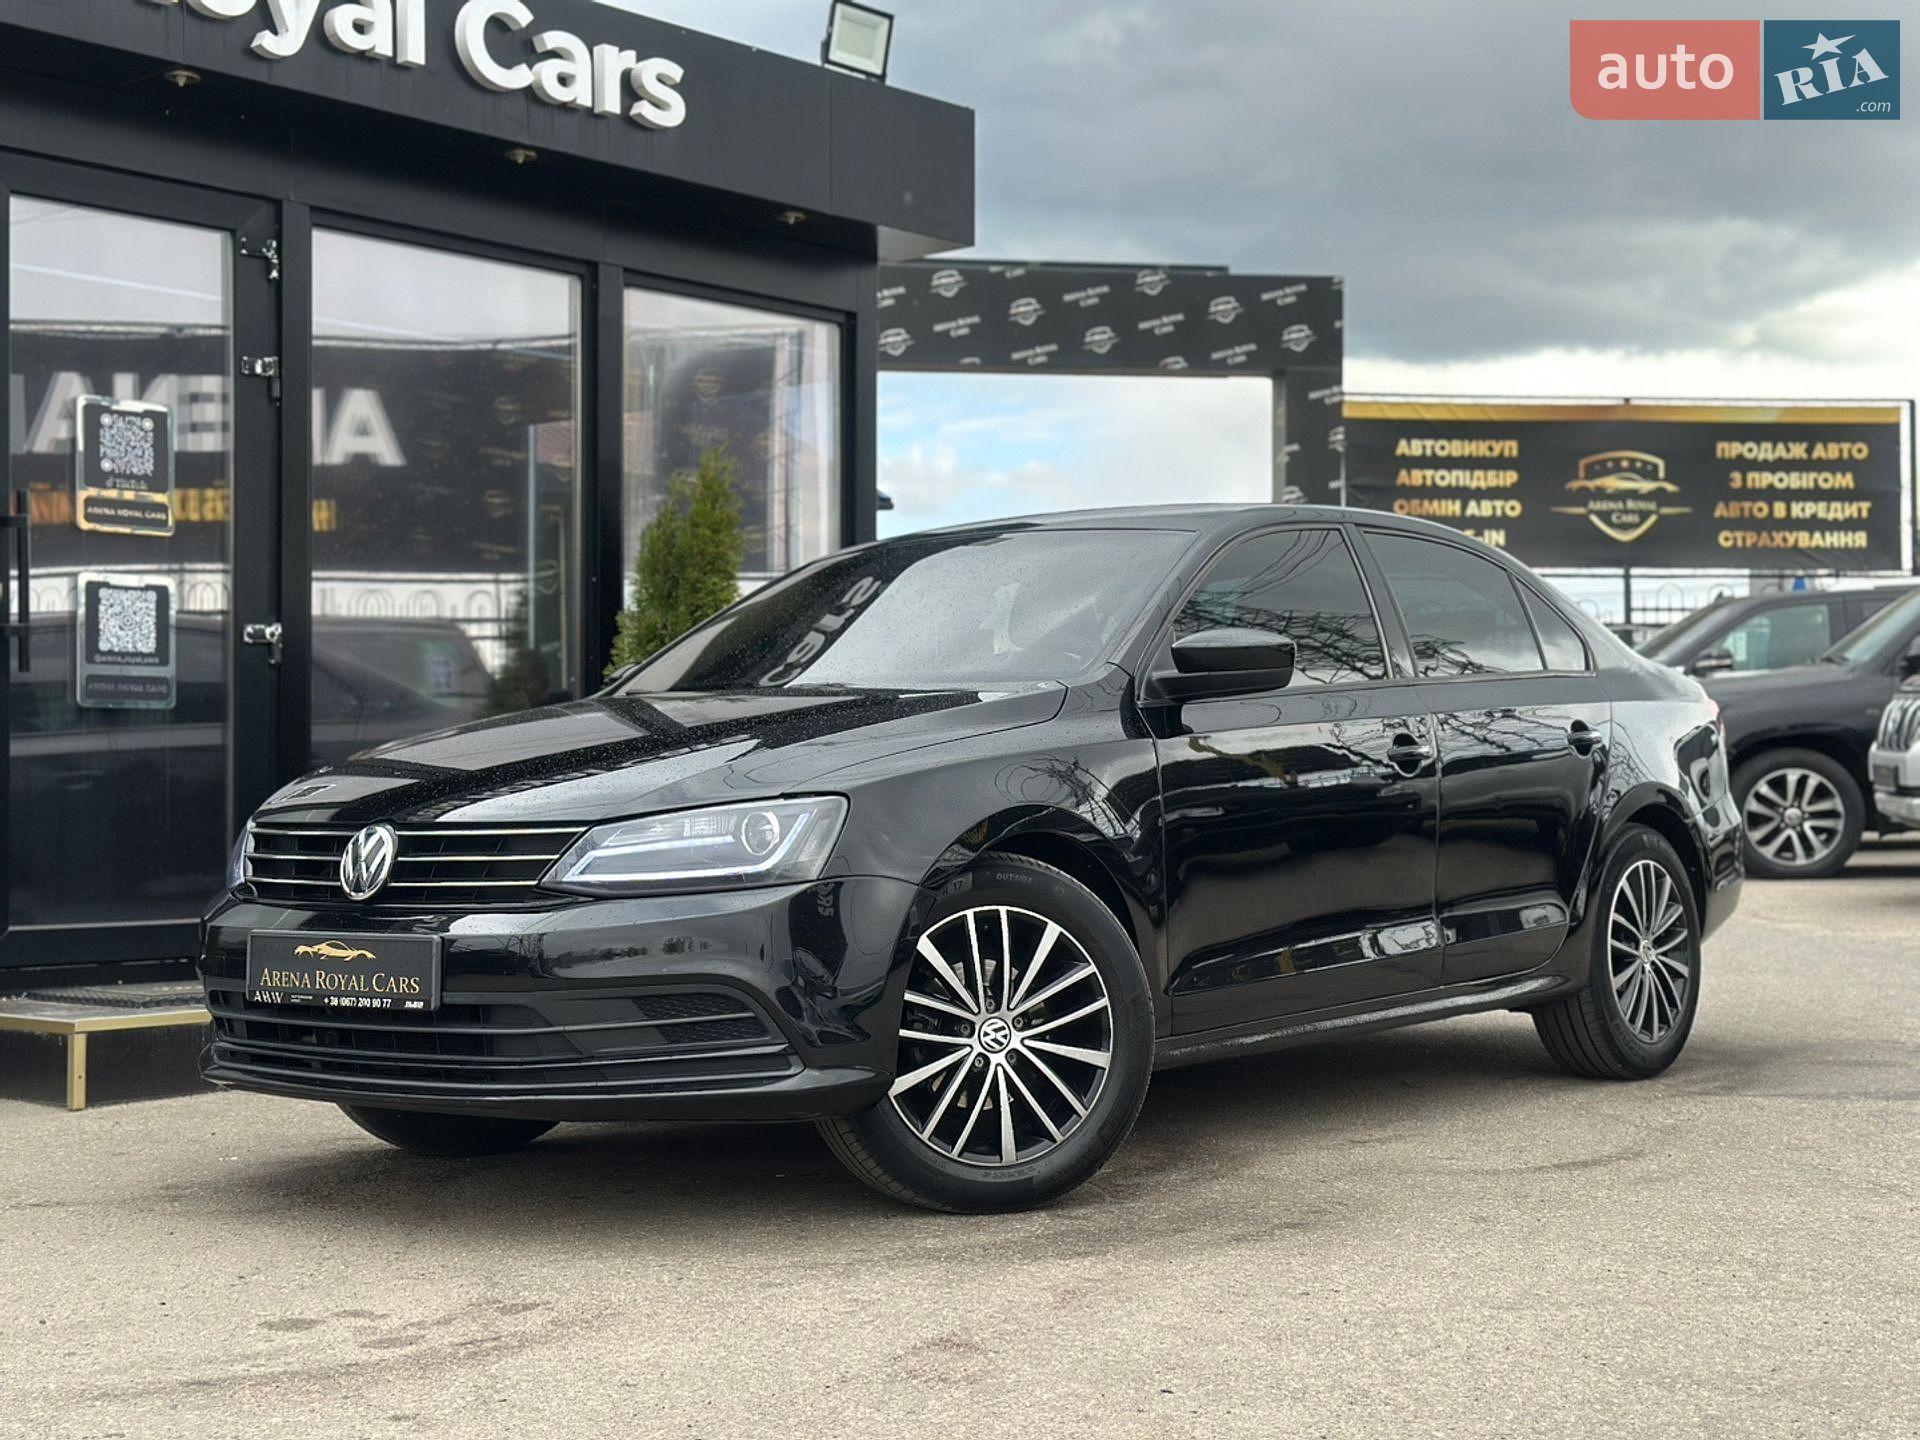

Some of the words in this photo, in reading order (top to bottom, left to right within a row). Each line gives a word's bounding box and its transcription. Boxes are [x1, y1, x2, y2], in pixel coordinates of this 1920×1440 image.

[137, 0, 426, 68] yal
[455, 0, 686, 130] Cars
[1395, 438, 1519, 458] АВТОВИКУП
[1716, 441, 1808, 462] ПРОДАЖ
[1811, 441, 1870, 461] АВТО
[1396, 468, 1519, 490] АВТОПІДБІР
[1729, 471, 1743, 489] З
[1746, 471, 1855, 489] ПРОБІГОМ
[1393, 498, 1460, 517] ОБМІН
[1465, 498, 1522, 518] АВТО
[1713, 501, 1769, 519] АВТО
[1772, 501, 1788, 519] В
[1790, 501, 1873, 522] КРЕДИТ
[1717, 530, 1869, 549] СТРАХУВАННЯ
[259, 967, 311, 989] ARENA
[315, 970, 369, 992] ROYAL
[372, 973, 420, 994] CARS
